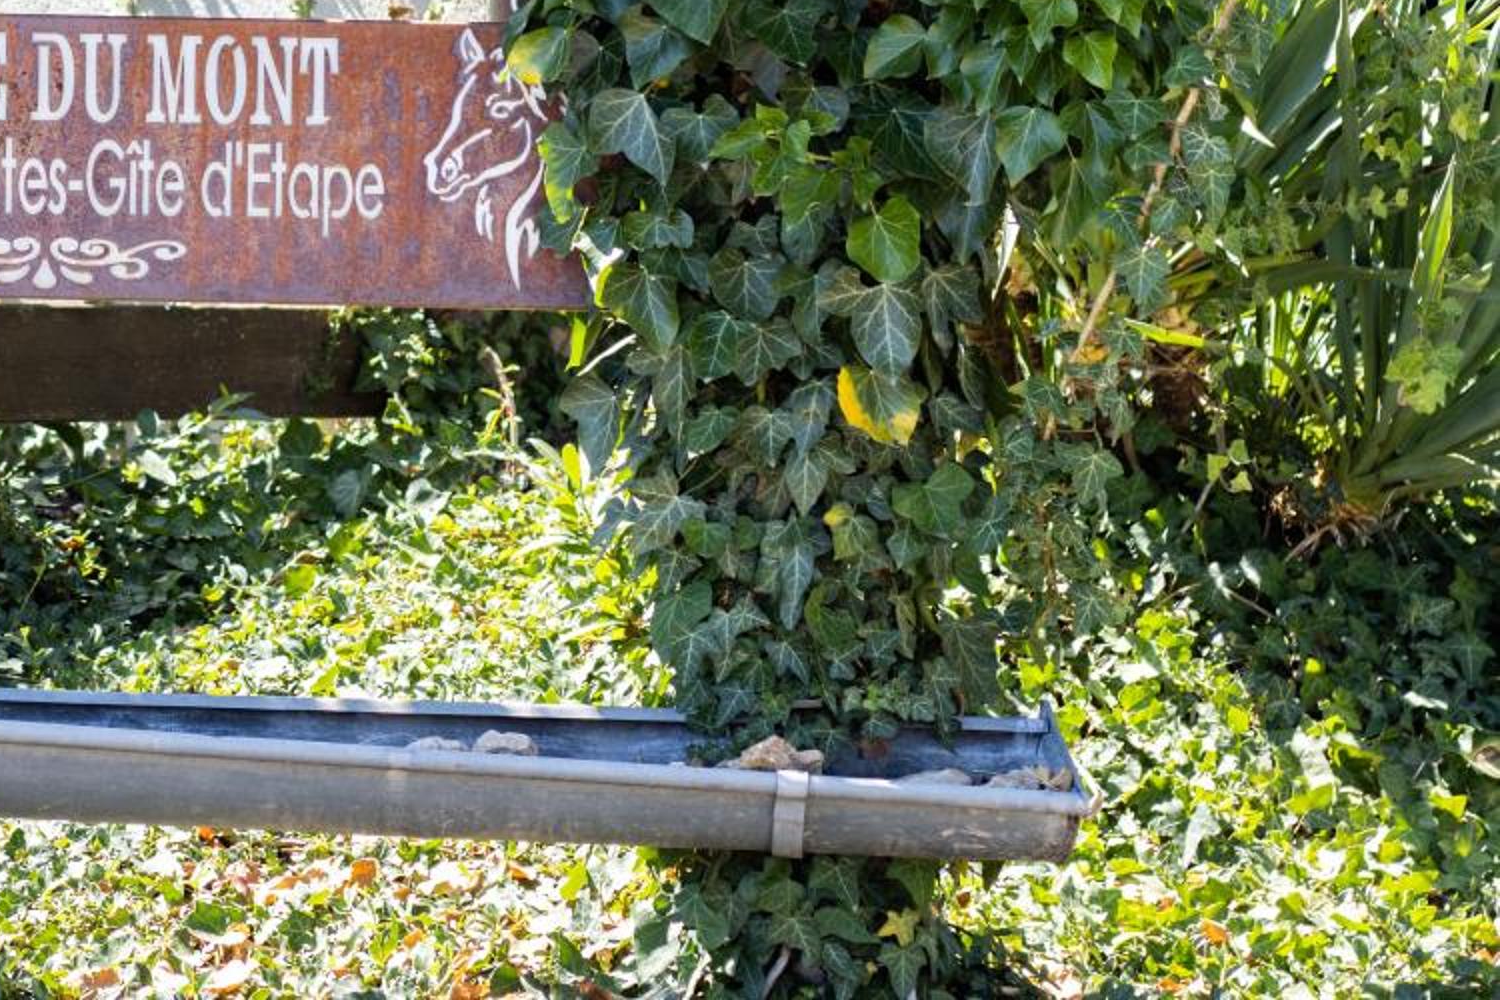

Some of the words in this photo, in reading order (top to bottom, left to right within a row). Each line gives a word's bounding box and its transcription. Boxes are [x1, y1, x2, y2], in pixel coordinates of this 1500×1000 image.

[30, 31, 128, 123] DU
[145, 33, 340, 126] MONT
[201, 140, 386, 238] d'Etape
